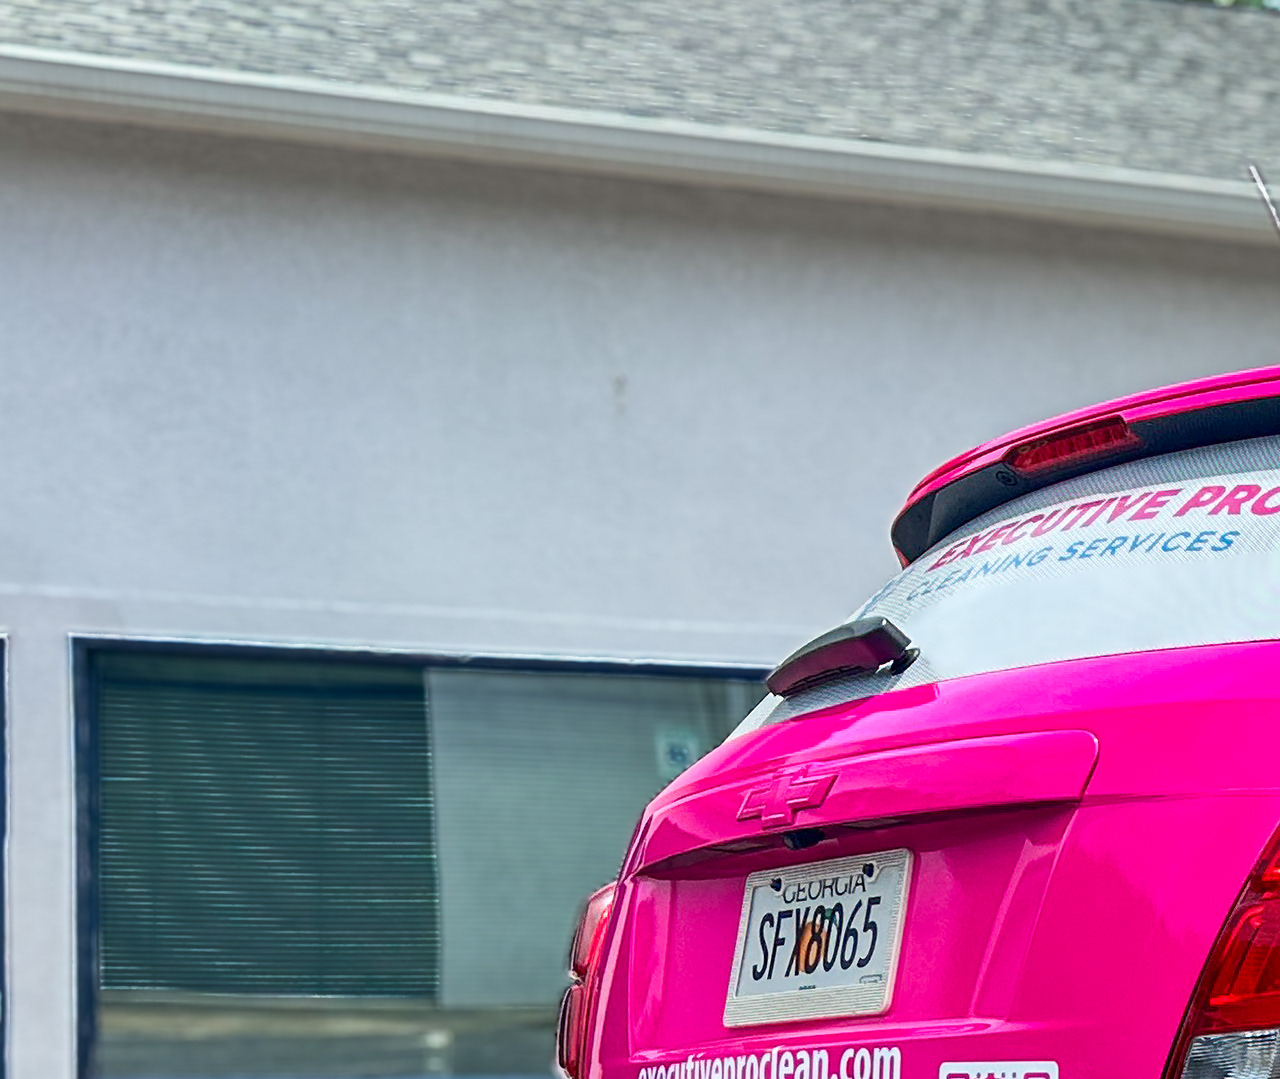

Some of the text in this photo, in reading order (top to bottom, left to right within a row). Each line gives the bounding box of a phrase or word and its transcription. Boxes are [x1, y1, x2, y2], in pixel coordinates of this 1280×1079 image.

[907, 530, 1241, 600] CLEANING SERVICES
[925, 488, 1190, 573] EXECUTIVE
[752, 896, 881, 981] SFX8065
